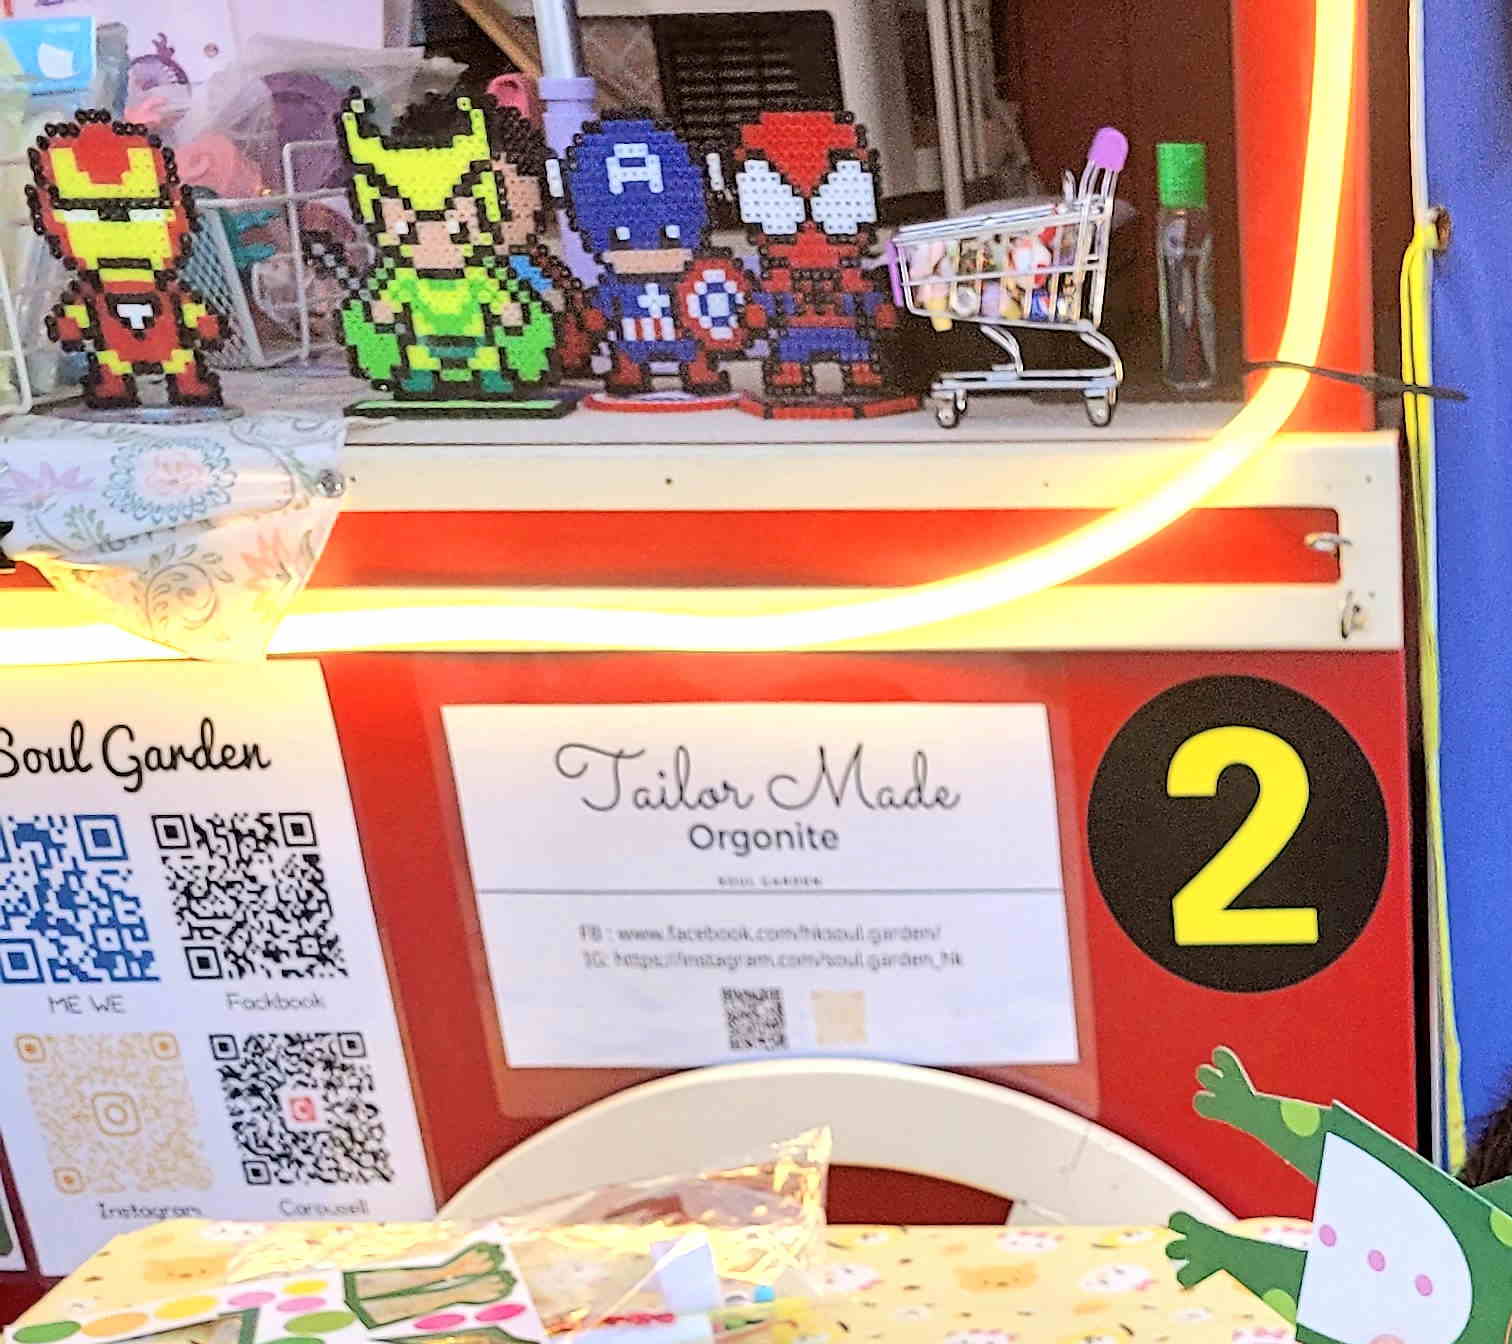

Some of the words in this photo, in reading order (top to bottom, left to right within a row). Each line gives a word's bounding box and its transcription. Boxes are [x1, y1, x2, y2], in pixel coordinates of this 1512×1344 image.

[0, 719, 93, 778] Soul
[101, 717, 272, 793] Garden
[555, 742, 754, 812] Tailor
[767, 742, 960, 812] Made
[688, 822, 840, 857] Orgonite
[1166, 725, 1320, 947] 2
